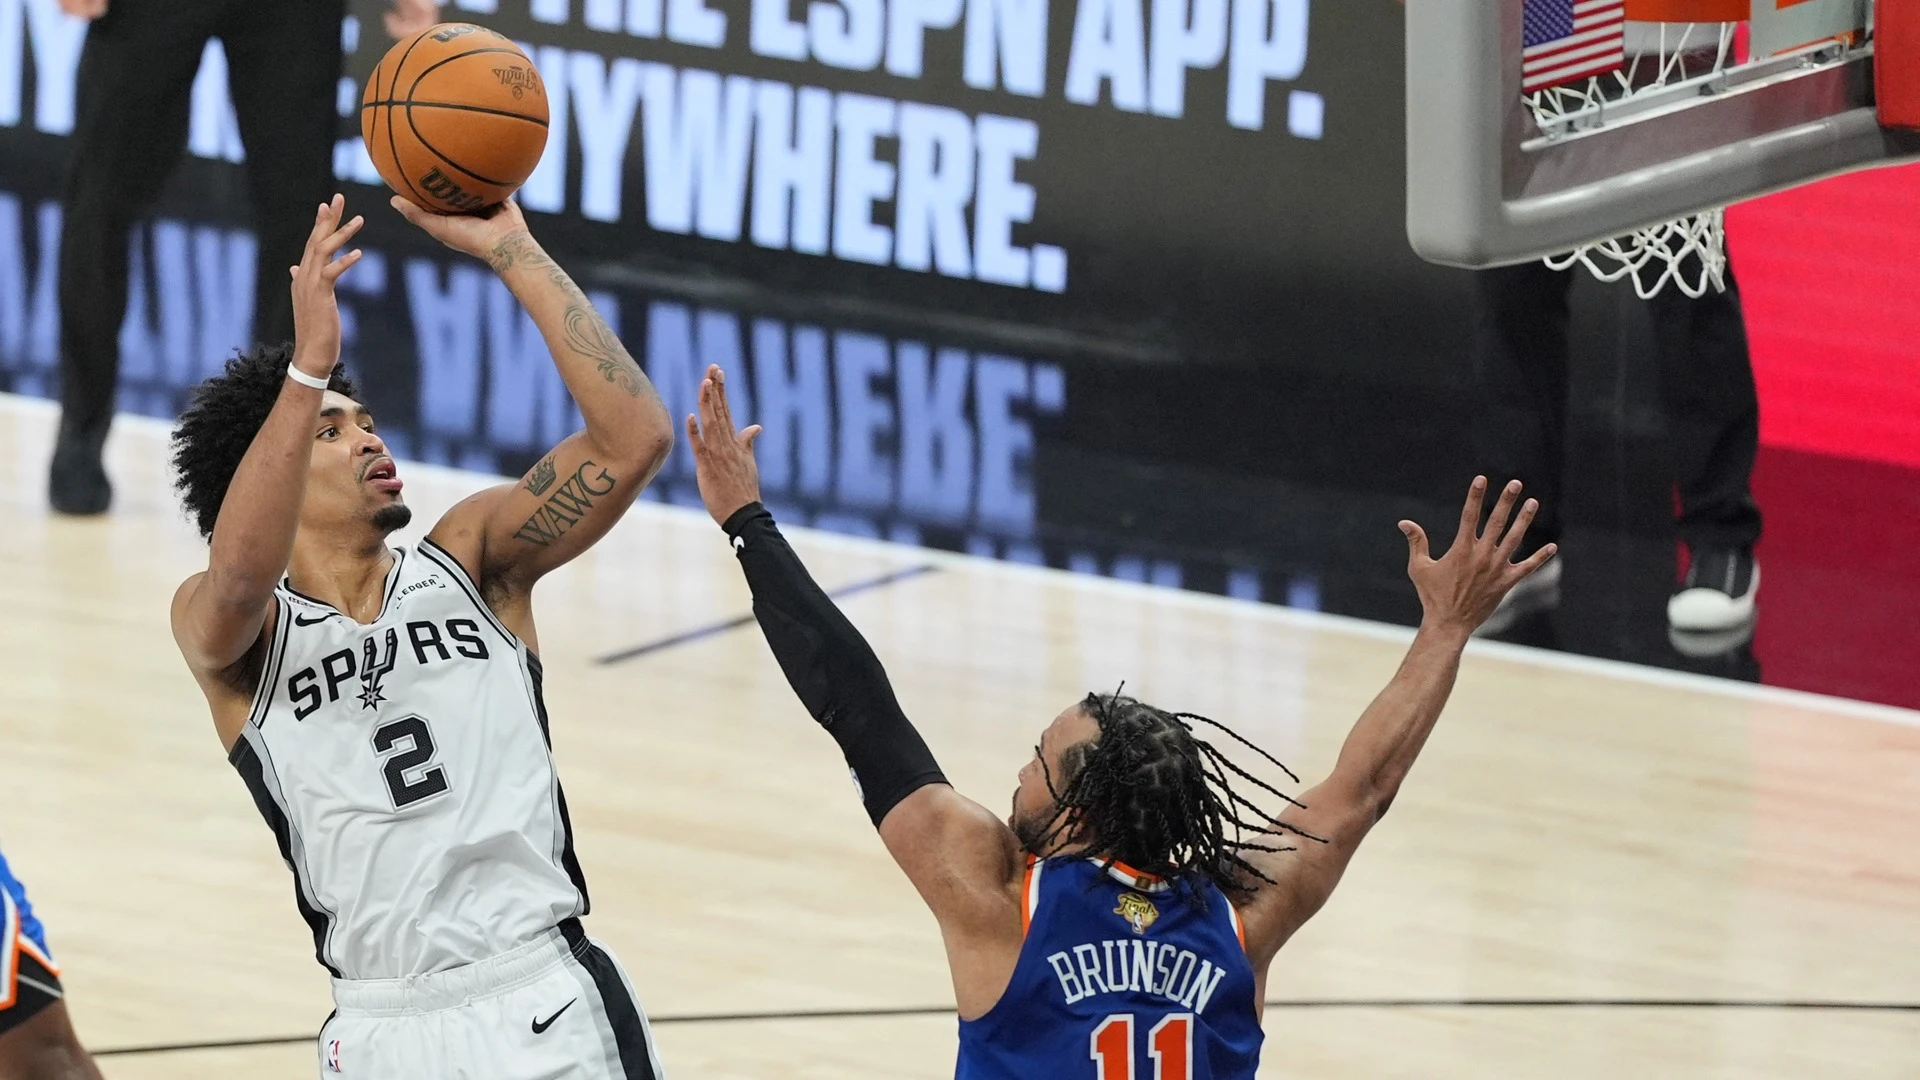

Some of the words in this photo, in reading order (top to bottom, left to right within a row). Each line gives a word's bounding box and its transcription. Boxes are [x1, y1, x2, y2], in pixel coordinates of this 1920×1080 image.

[1064, 0, 1324, 141] APP.
[518, 40, 1068, 293] YWHERE.
[512, 460, 616, 547] WAWG
[397, 578, 437, 601] LEDGER
[288, 619, 490, 722] SPURS
[369, 712, 453, 813] 2
[1047, 939, 1226, 1015] BRUNSON
[1090, 1013, 1194, 1080] 11
